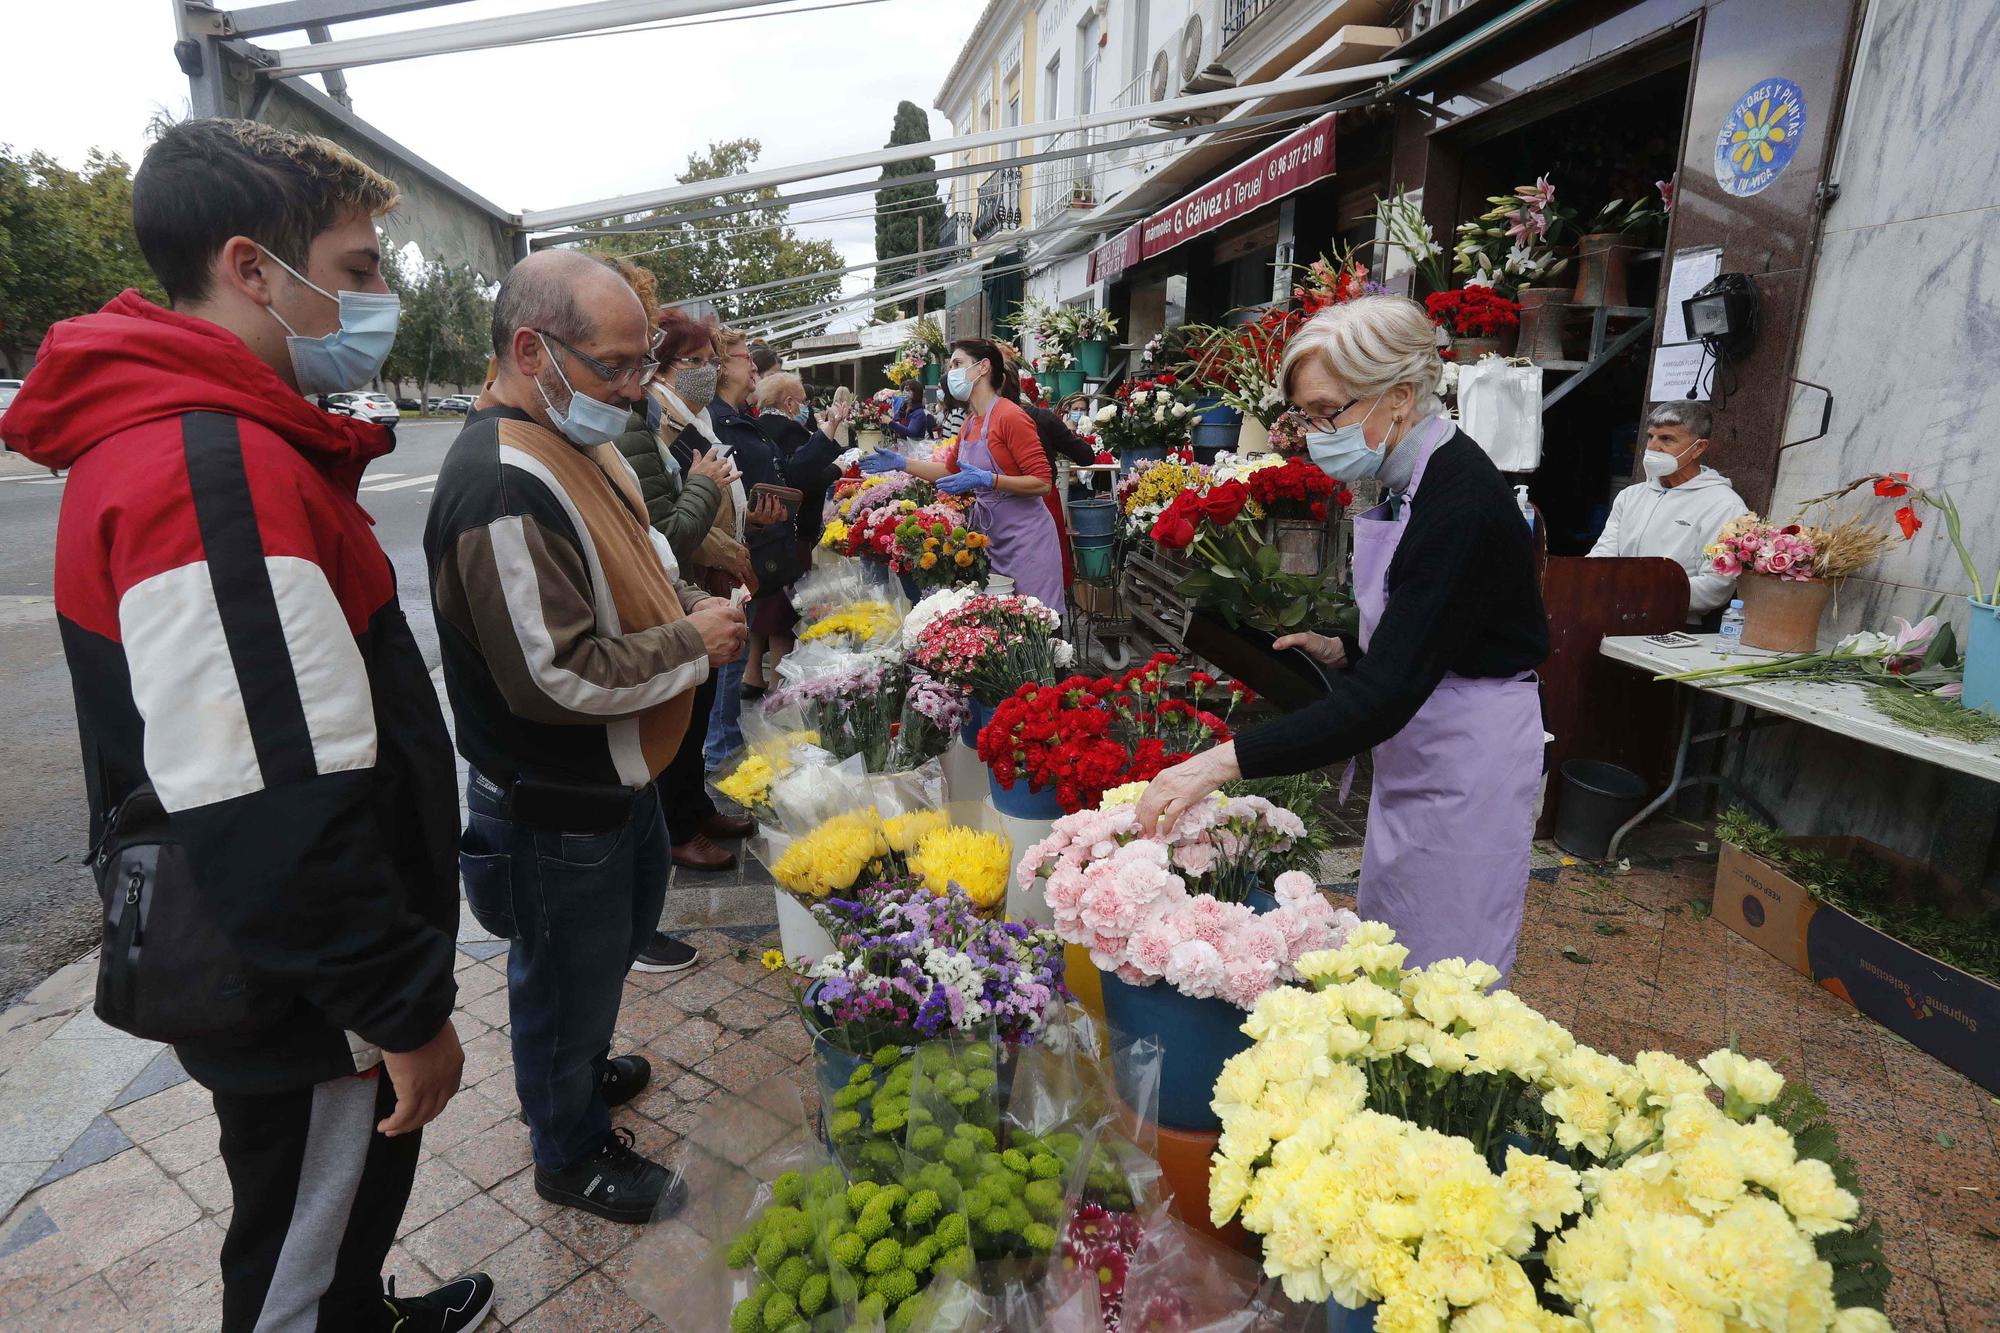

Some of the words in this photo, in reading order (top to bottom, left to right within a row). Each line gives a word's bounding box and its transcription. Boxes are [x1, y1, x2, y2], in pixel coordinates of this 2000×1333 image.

[1735, 85, 1772, 118] FLORES
[1773, 84, 1782, 98] Y
[1780, 87, 1801, 137] PLANTAS
[1185, 192, 1222, 229] Gálvez
[1224, 187, 1231, 208] &
[1233, 170, 1262, 206] Teruel
[1277, 157, 1287, 176] 96
[1287, 147, 1301, 171] 377
[1302, 140, 1312, 164] 21
[1313, 134, 1324, 157] 80
[1745, 874, 1763, 890] COLD
[1763, 886, 1782, 903] KEEP
[1925, 995, 1977, 1032] Supreme
